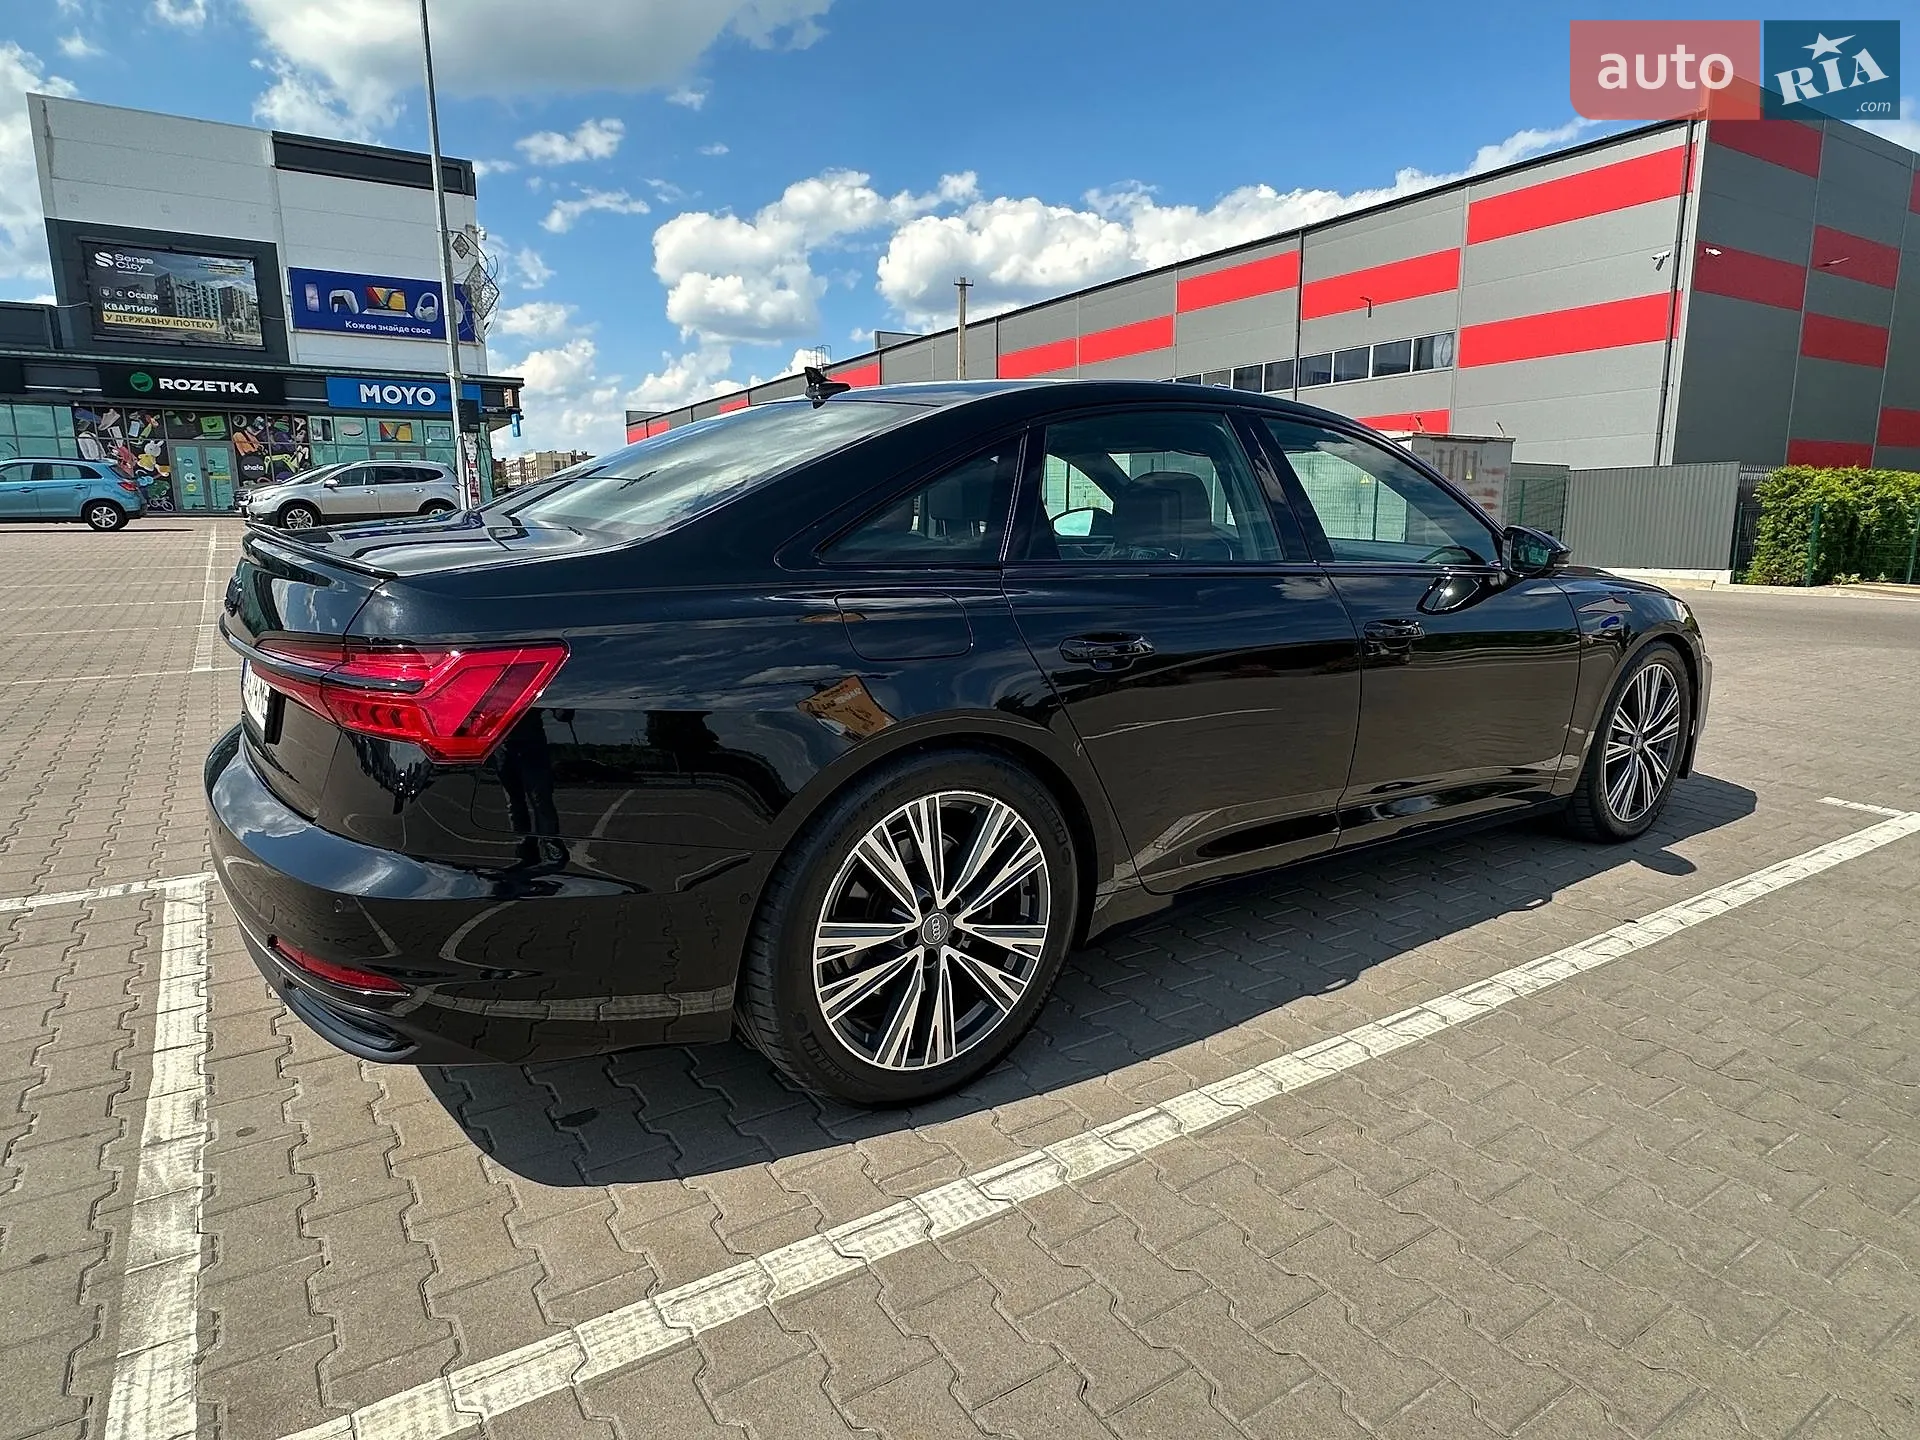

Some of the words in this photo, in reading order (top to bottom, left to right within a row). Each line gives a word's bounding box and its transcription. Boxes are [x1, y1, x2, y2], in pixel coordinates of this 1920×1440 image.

[114, 253, 154, 265] Sense
[116, 261, 144, 272] City
[103, 302, 158, 314] КВАРТИРИ
[115, 315, 171, 326] ДЕРЖАВНУ
[173, 319, 215, 329] ІПОТЕКУ
[345, 320, 377, 330] Кожен
[378, 324, 410, 333] знайде
[158, 378, 259, 394] ROZETKA
[359, 384, 436, 406] MOYO
